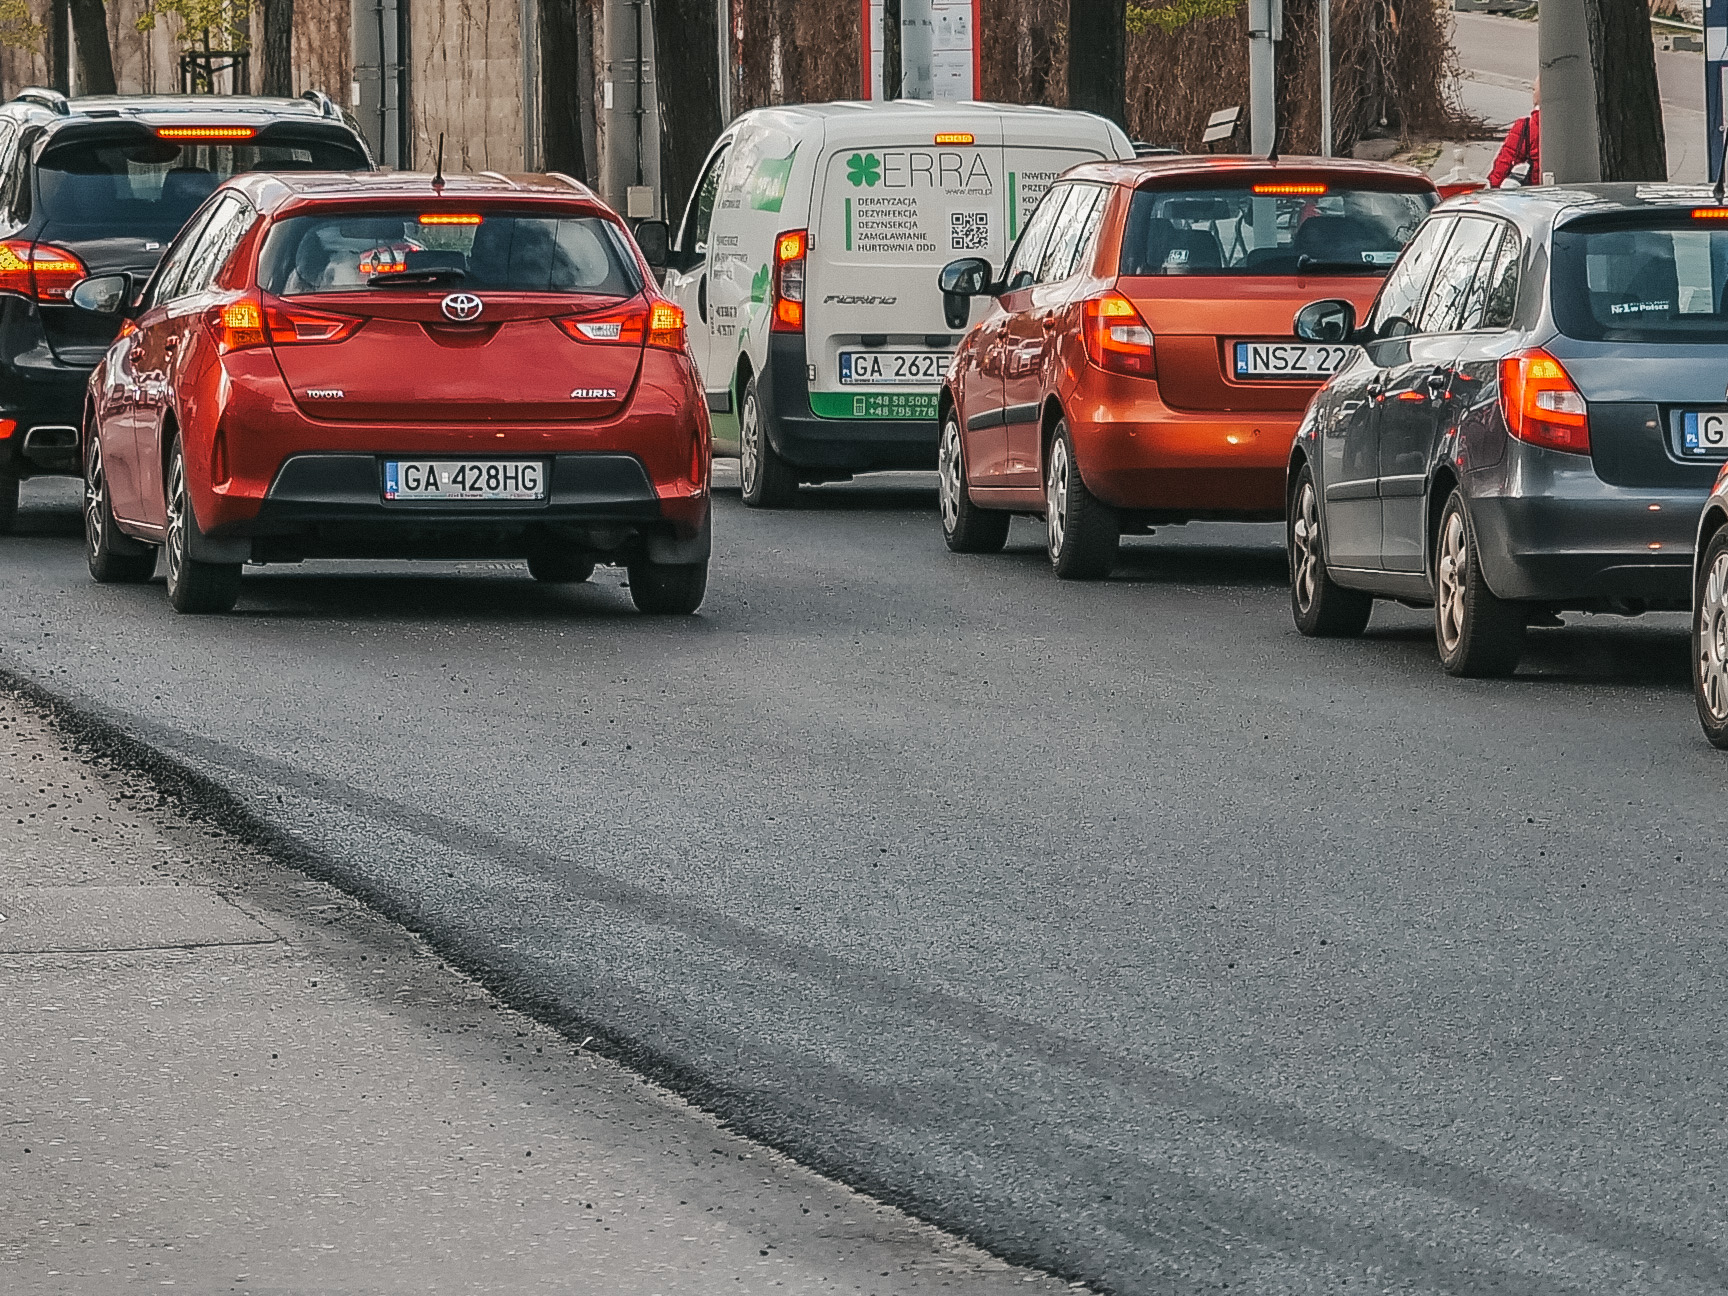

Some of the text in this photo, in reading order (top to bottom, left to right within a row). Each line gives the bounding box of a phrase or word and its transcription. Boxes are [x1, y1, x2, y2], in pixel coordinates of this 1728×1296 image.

[883, 152, 993, 188] ERRA
[858, 198, 917, 206] DERATYZACJA
[858, 210, 918, 219] DEZYNFEKCJA
[858, 221, 918, 230] DEZYNSEKCJA
[858, 244, 936, 252] HURTOWNIA DDD
[1253, 346, 1308, 371] NSZ
[854, 356, 955, 377] GA 262E
[307, 390, 344, 398] TOYOTA
[571, 389, 616, 398] AURIS
[892, 396, 905, 405] 58
[404, 464, 538, 492] GA 428HG
